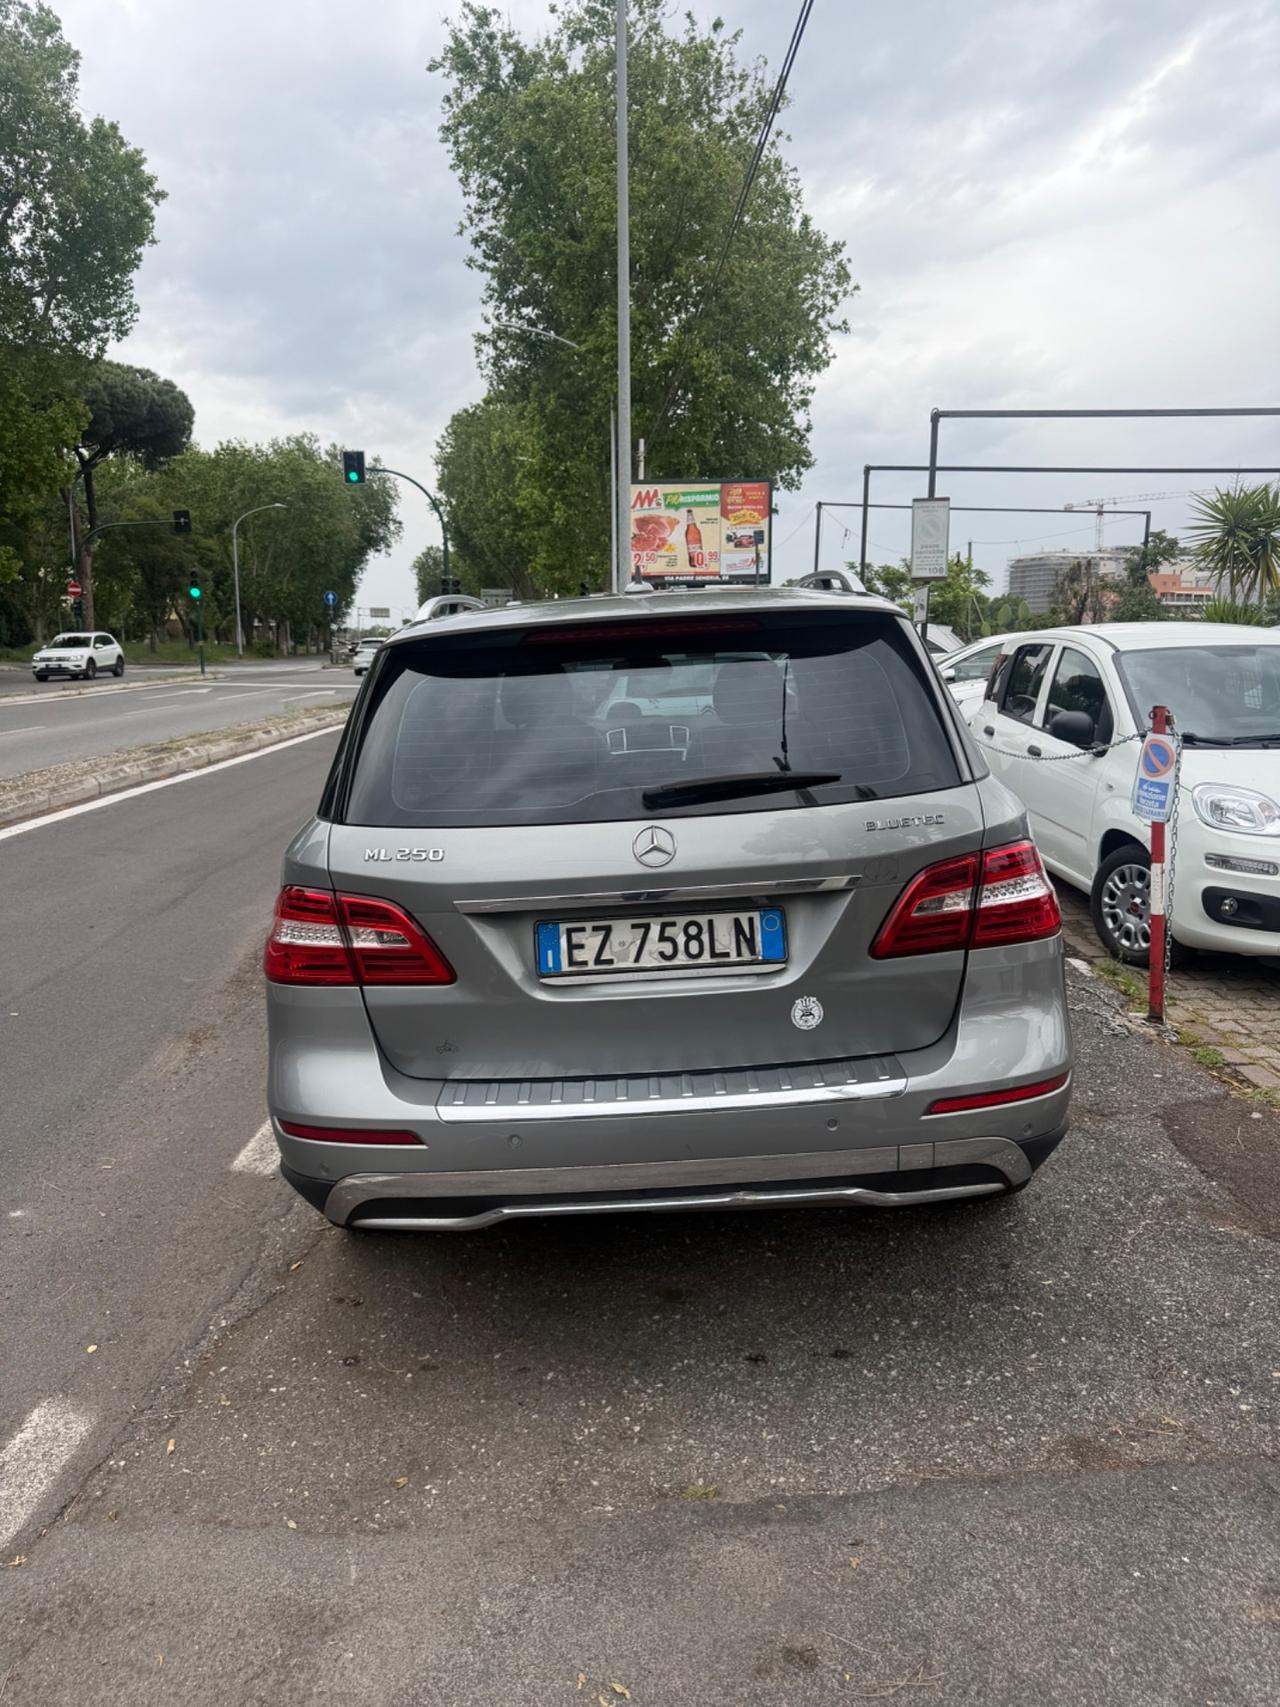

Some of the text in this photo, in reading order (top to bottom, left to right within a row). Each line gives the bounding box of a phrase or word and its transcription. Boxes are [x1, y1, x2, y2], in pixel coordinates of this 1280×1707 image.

[864, 814, 945, 832] BLUETEC
[364, 847, 445, 862] ML 250
[566, 916, 758, 968] EZ 758LN
